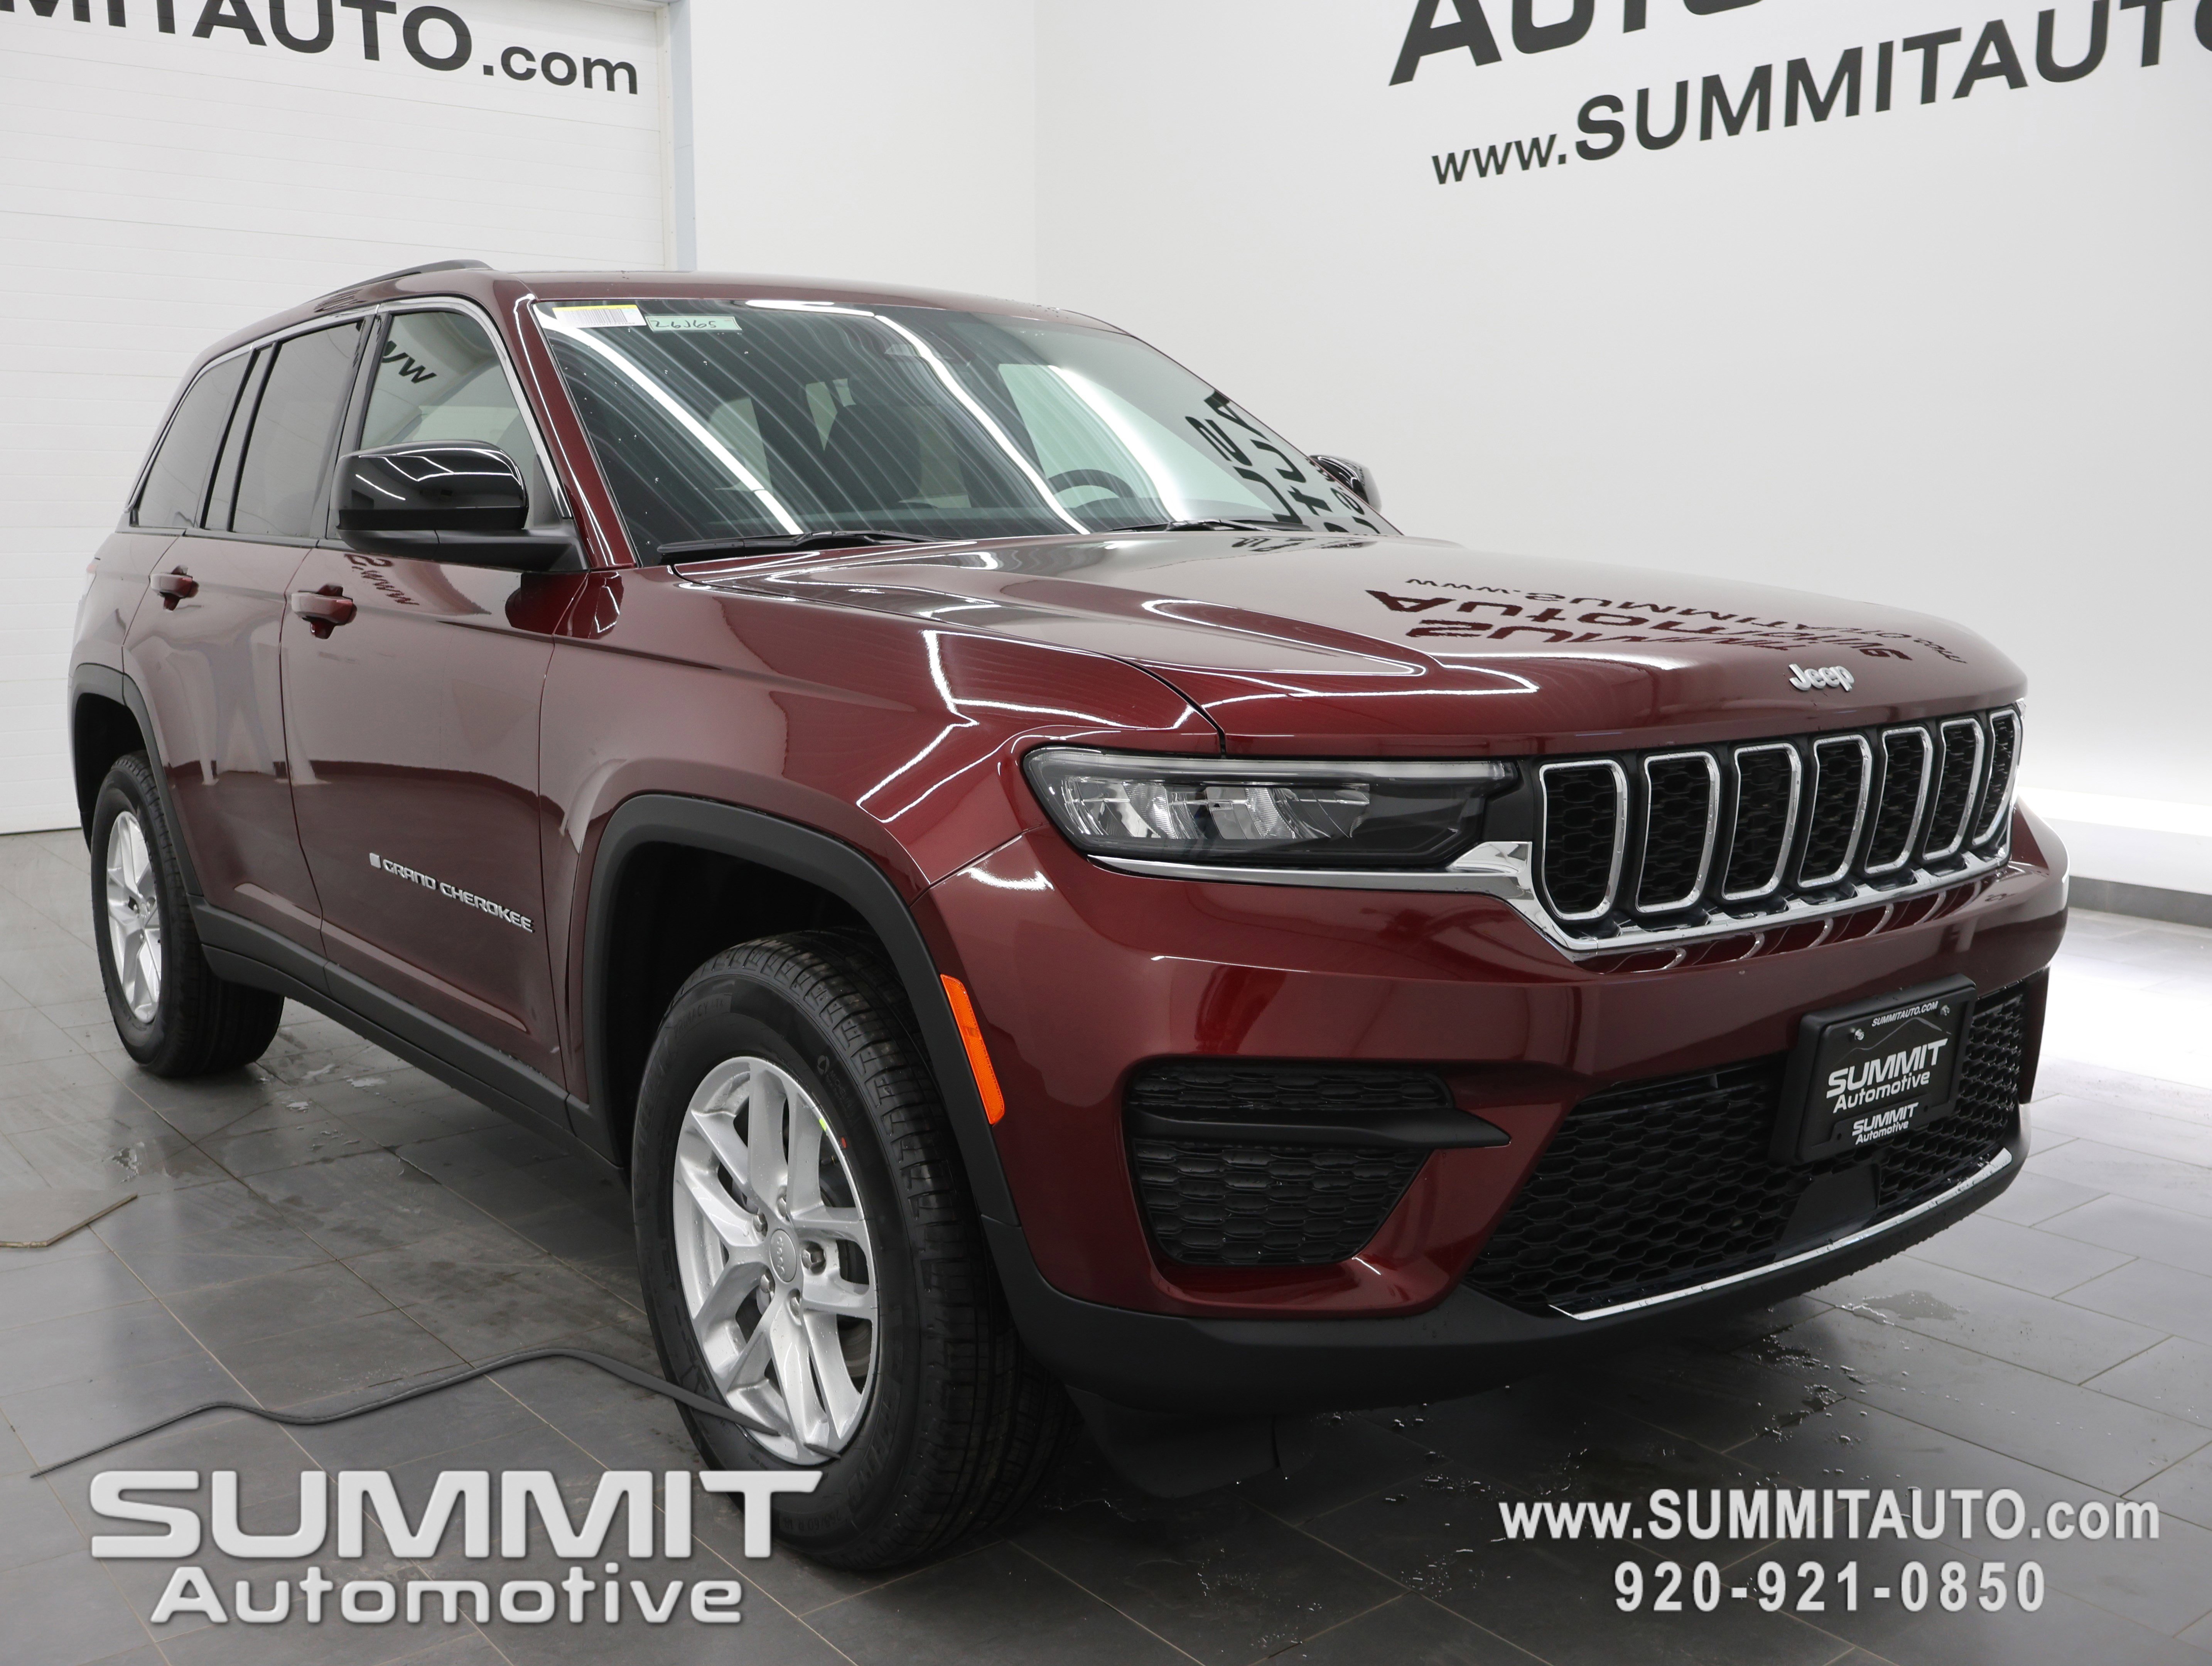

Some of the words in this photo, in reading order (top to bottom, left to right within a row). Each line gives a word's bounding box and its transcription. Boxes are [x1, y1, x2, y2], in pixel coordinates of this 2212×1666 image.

[1788, 663, 1854, 691] Jeep
[383, 859, 437, 890] GRAND
[440, 882, 535, 933] CHEROKEE
[1871, 1001, 1939, 1027] SUMMITAUTO.COM
[1826, 1038, 1948, 1098] SUMMIT
[1833, 1071, 1930, 1113] Automotive
[1852, 1102, 1919, 1136] SUMMIT
[1855, 1120, 1909, 1145] Automotive
[777, 1236, 785, 1274] Jeep
